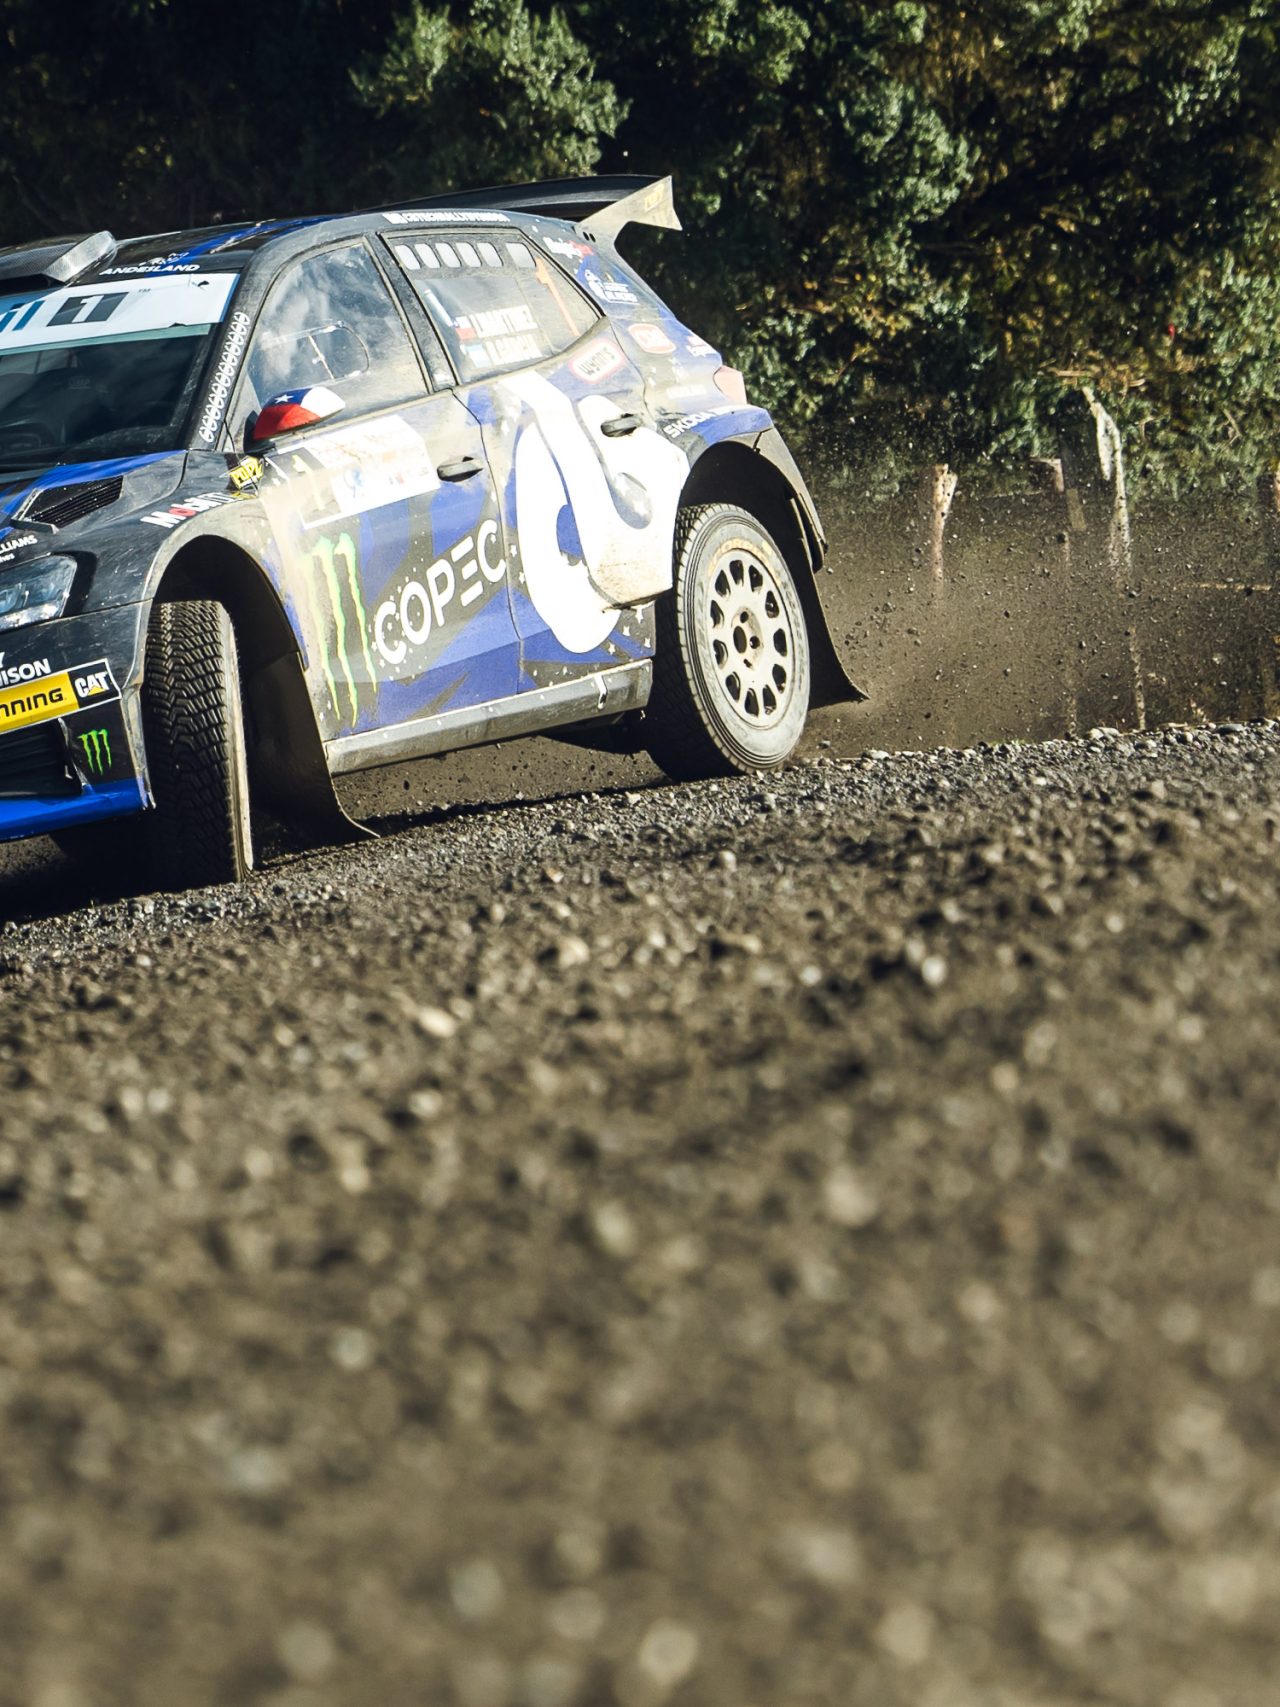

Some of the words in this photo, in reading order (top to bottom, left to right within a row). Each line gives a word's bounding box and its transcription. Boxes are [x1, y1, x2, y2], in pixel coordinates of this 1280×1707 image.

[140, 493, 222, 528] Mobil
[375, 519, 507, 664] COPEC
[74, 671, 110, 698] CAT
